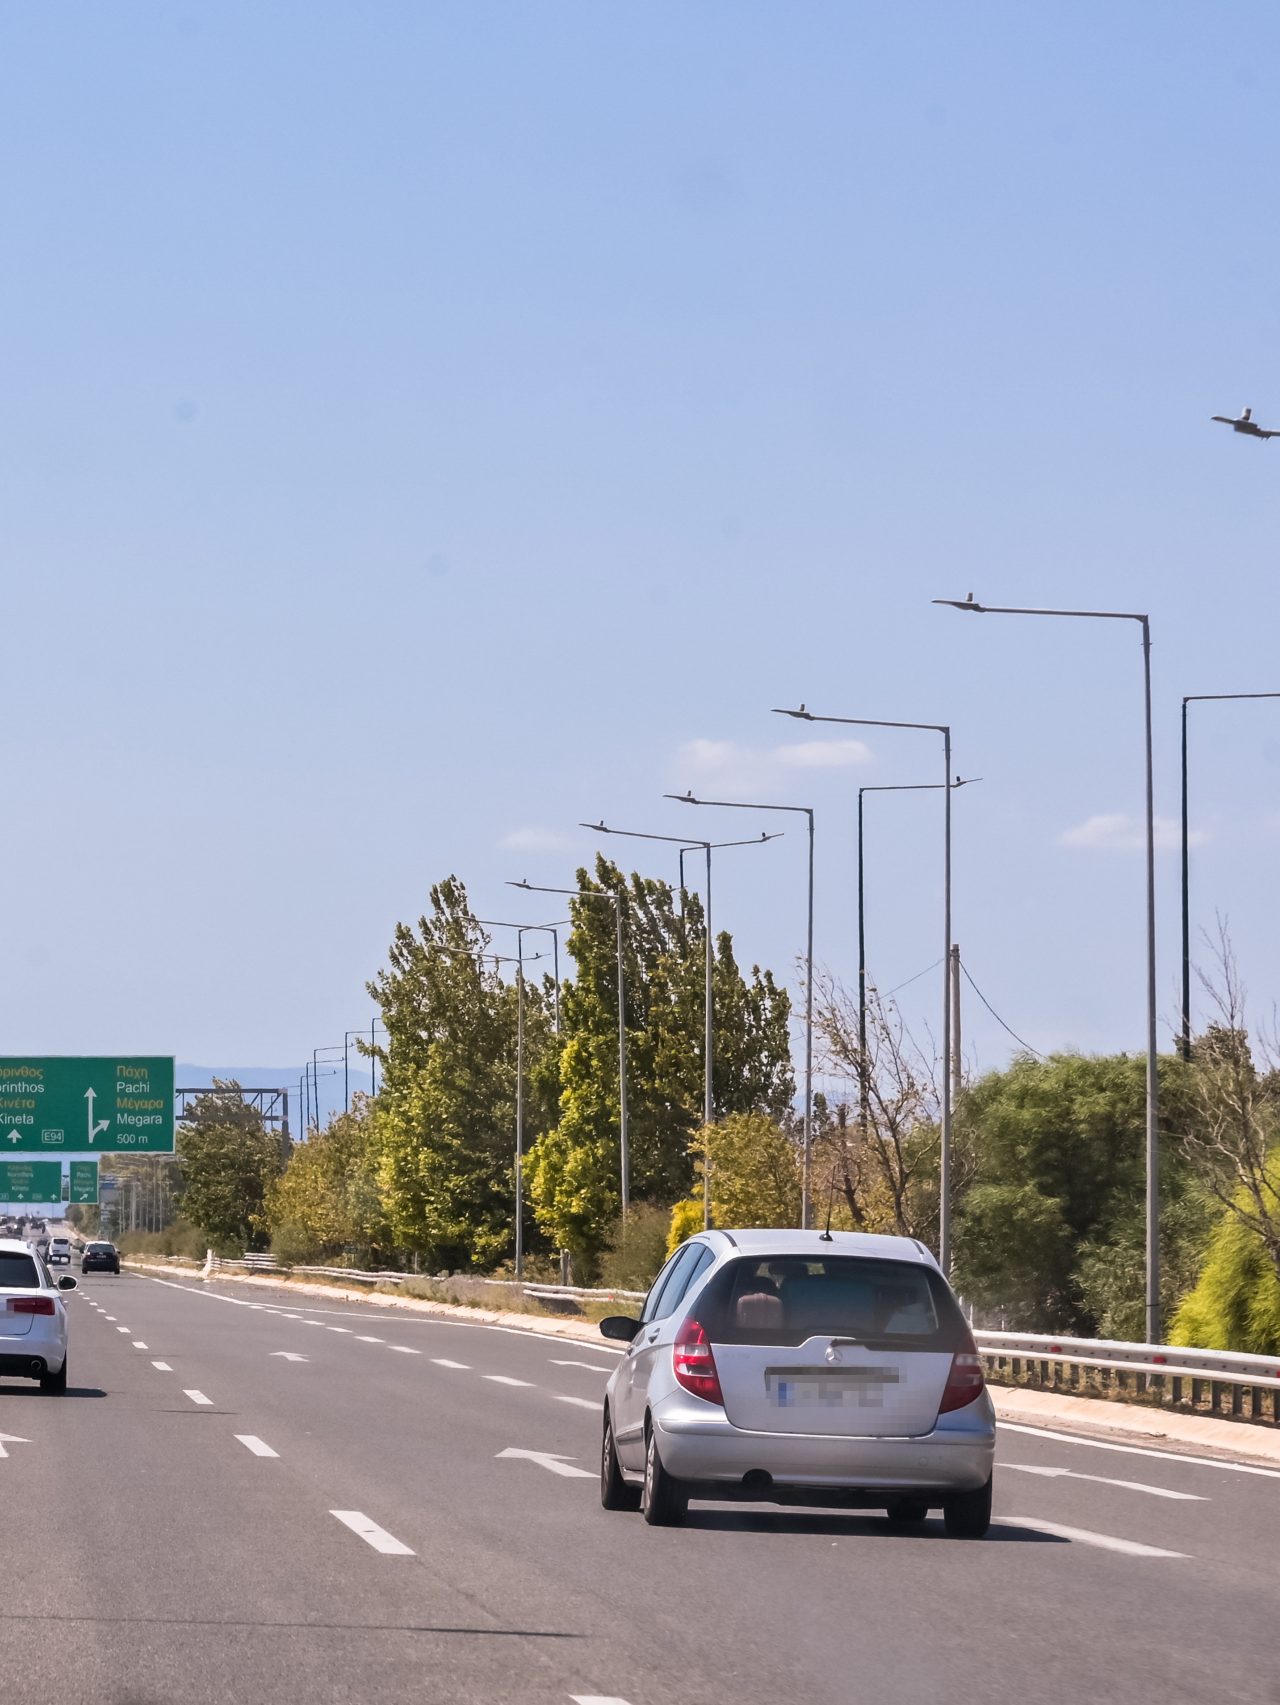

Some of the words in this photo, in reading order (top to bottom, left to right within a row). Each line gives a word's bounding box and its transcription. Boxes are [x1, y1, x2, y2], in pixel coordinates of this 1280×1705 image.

[117, 1065, 148, 1079] Πάχη
[116, 1081, 150, 1093] Pachi
[116, 1097, 164, 1110] Μέγαρα
[116, 1113, 162, 1127] Megara
[44, 1132, 62, 1141] E94
[116, 1134, 136, 1144] 500
[138, 1136, 148, 1144] m
